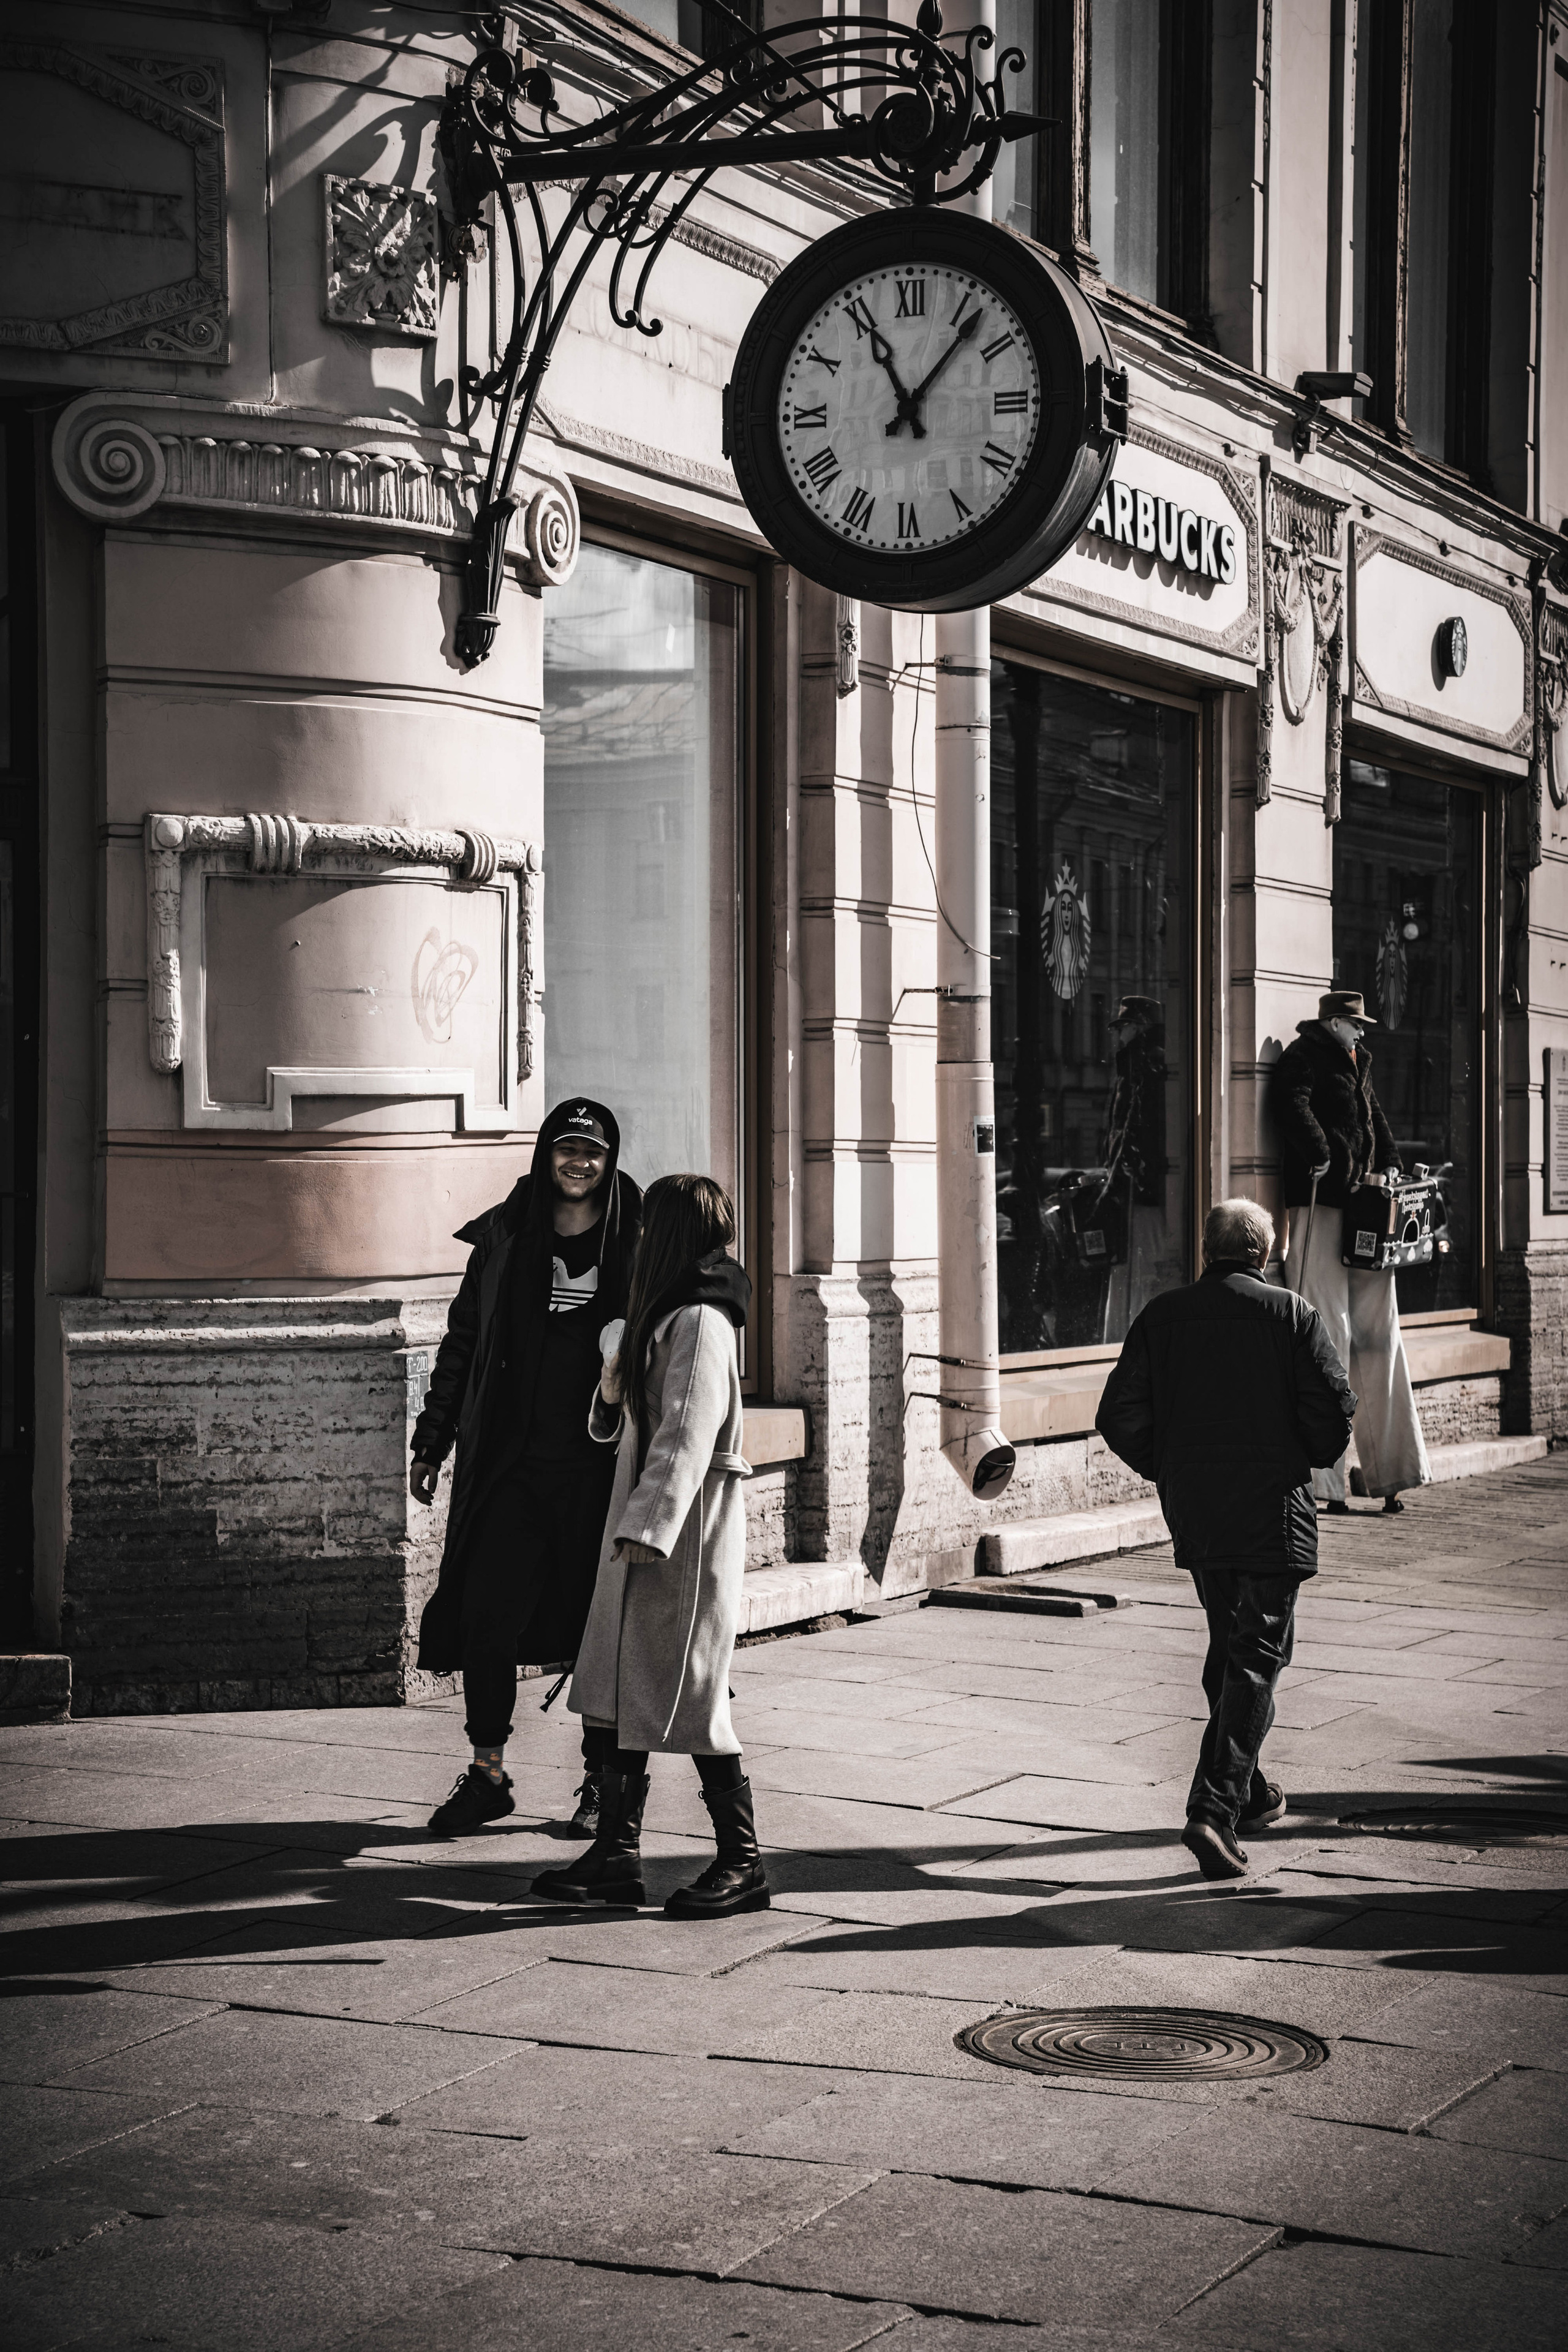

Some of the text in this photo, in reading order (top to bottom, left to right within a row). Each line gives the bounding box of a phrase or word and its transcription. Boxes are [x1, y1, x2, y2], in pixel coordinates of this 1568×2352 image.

[895, 279, 925, 317] XII
[949, 292, 972, 326] I
[842, 296, 878, 340] XI
[806, 345, 842, 377] X
[980, 331, 1016, 363] II
[794, 403, 827, 430] IX
[994, 390, 1028, 415] III
[802, 446, 842, 495] VIII
[980, 440, 1017, 479] IV
[840, 486, 876, 533] VII
[897, 502, 921, 538] VI
[949, 488, 973, 522] V
[568, 1117, 592, 1125] vataga
